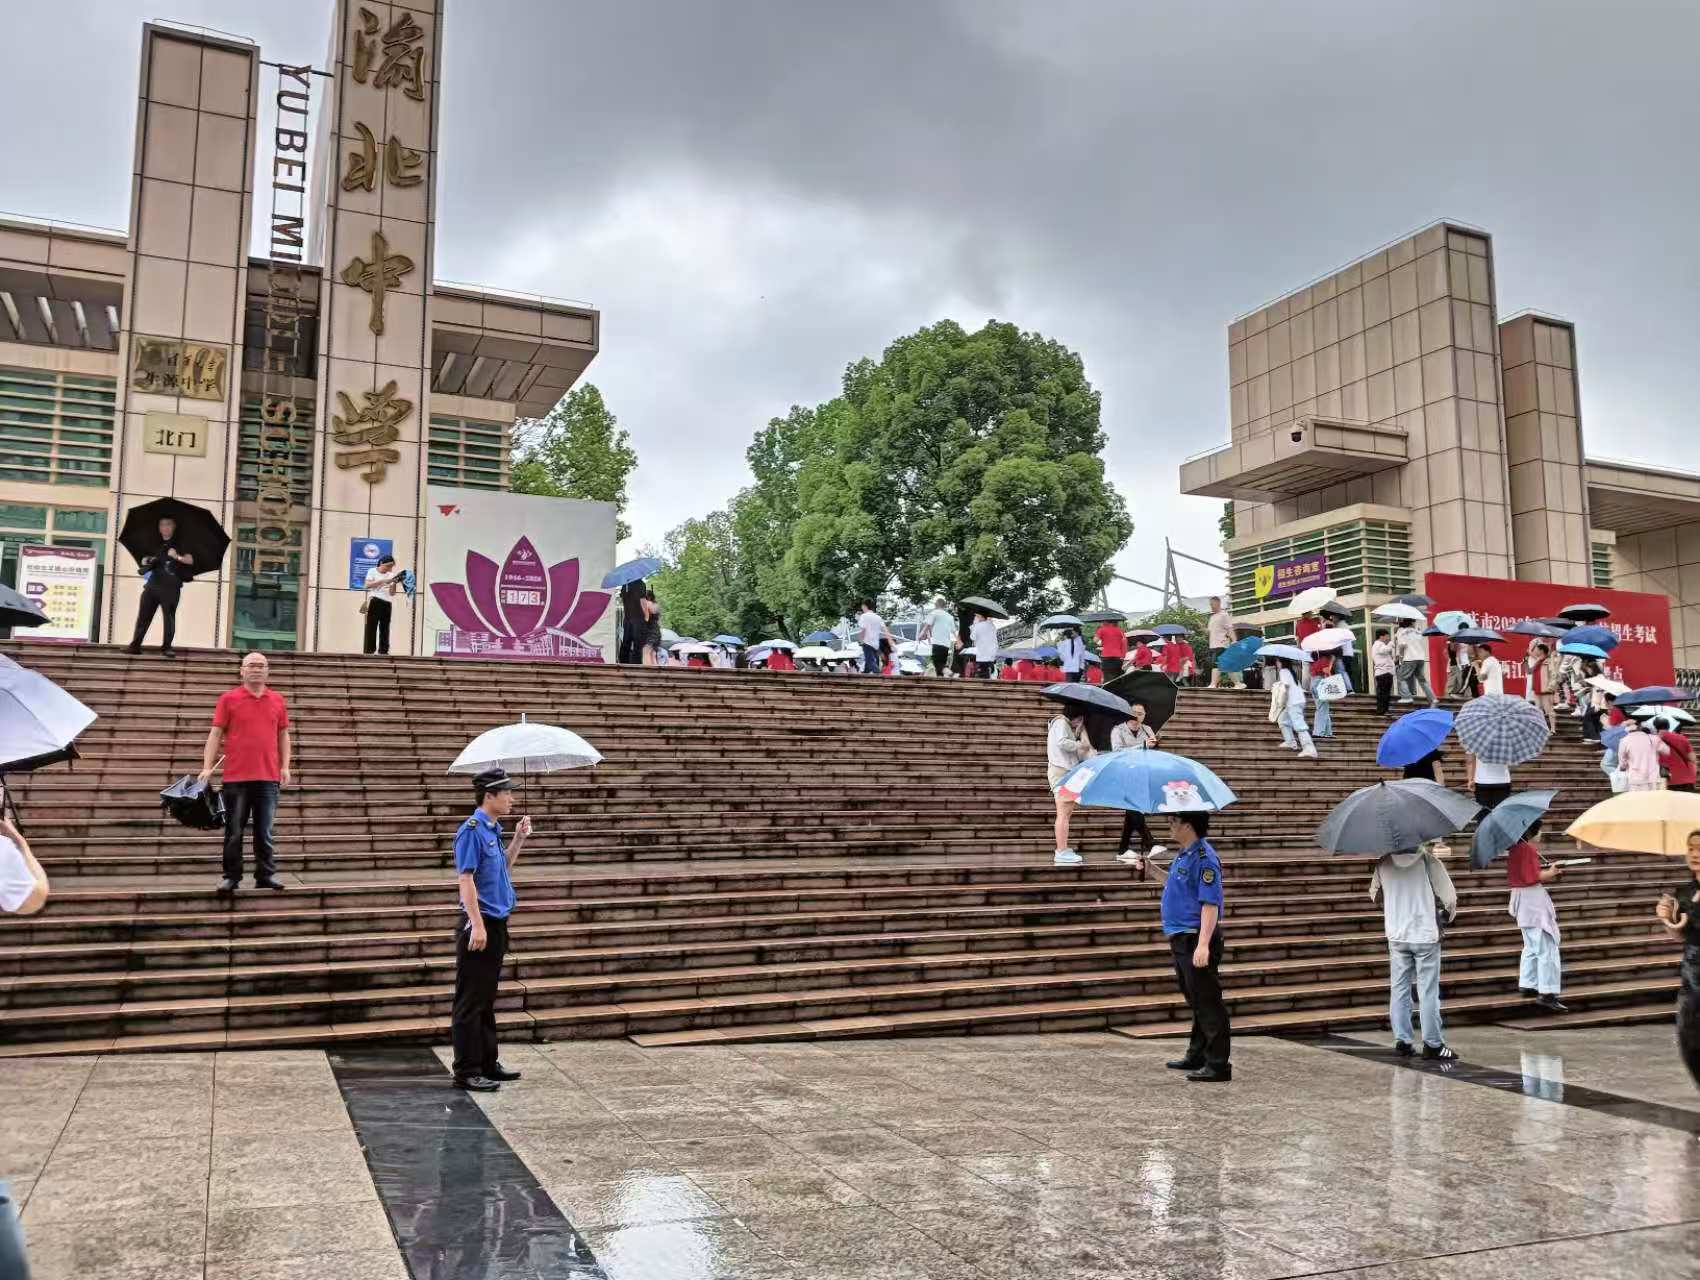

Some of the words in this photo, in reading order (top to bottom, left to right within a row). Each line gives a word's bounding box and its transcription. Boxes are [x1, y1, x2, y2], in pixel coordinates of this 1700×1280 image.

[277, 63, 312, 116] YU
[272, 126, 308, 194] BEI
[331, 6, 424, 485] 渝北中学
[155, 429, 196, 448] 北门
